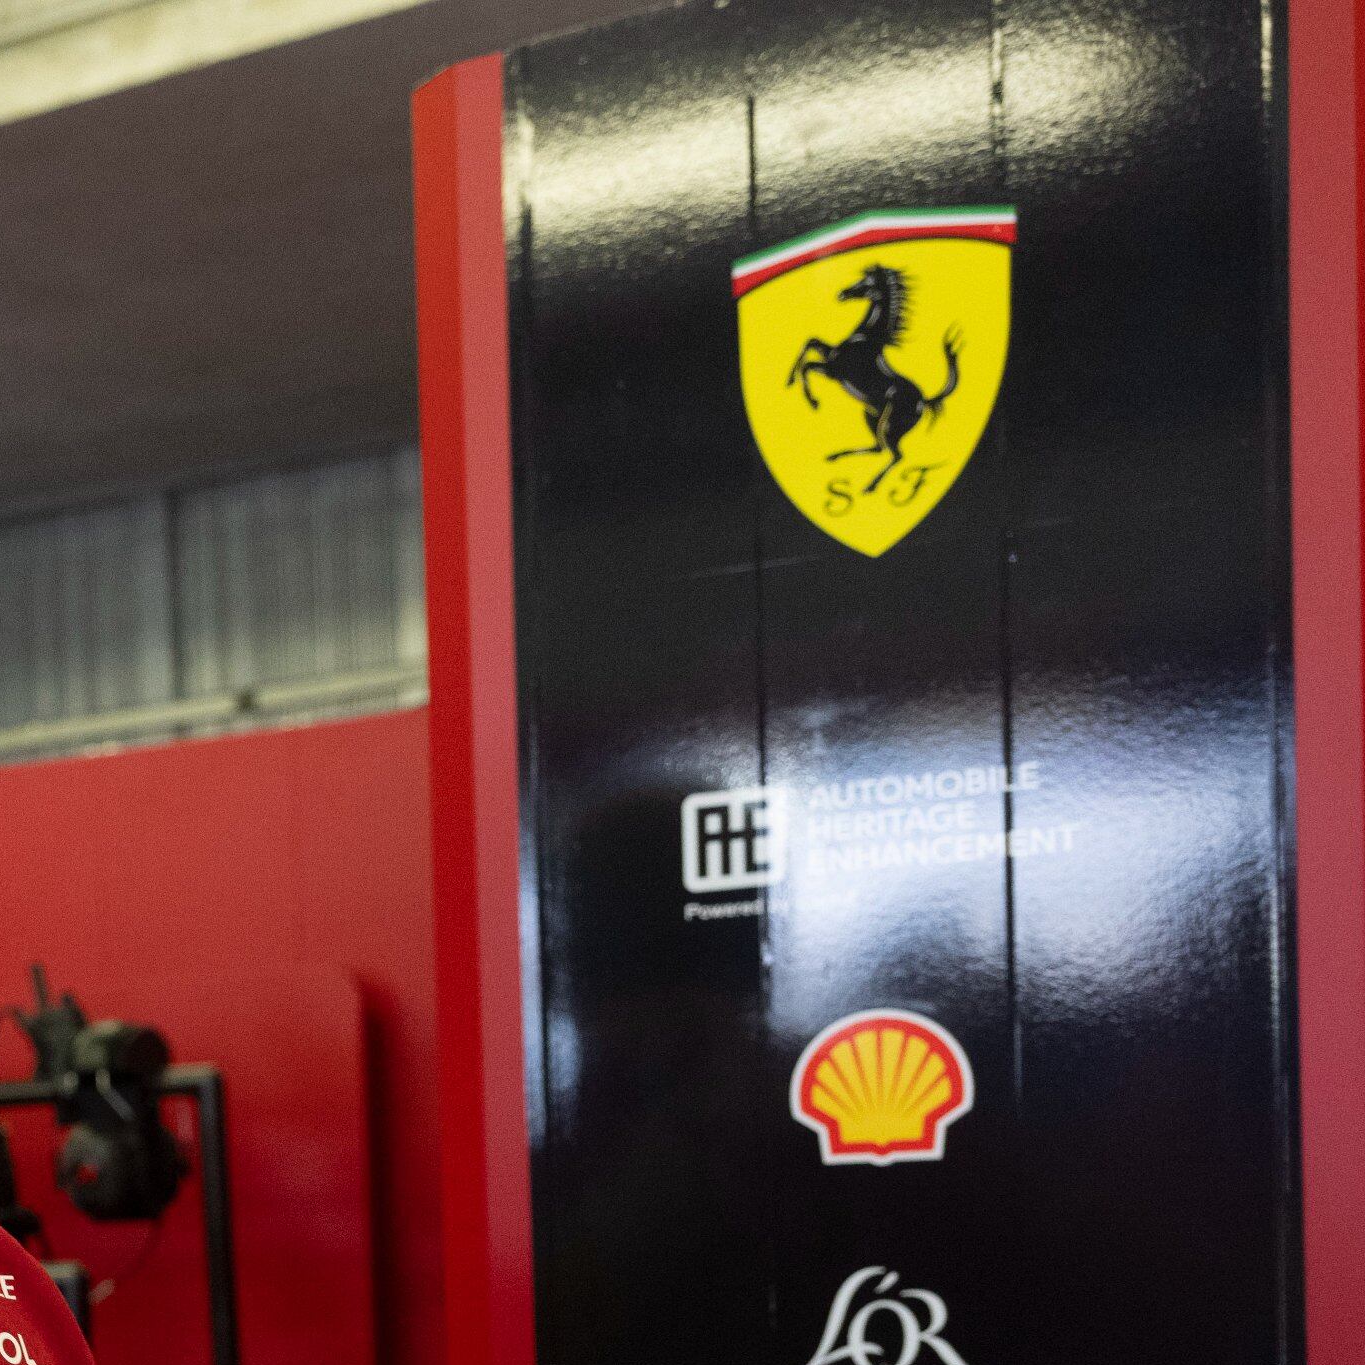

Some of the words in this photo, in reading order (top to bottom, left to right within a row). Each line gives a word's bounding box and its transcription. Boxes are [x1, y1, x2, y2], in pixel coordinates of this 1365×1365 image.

[807, 761, 1041, 808] AUTOMOBILE
[806, 801, 977, 840] HERITAGE
[806, 820, 1081, 875] ENHANCEMENT
